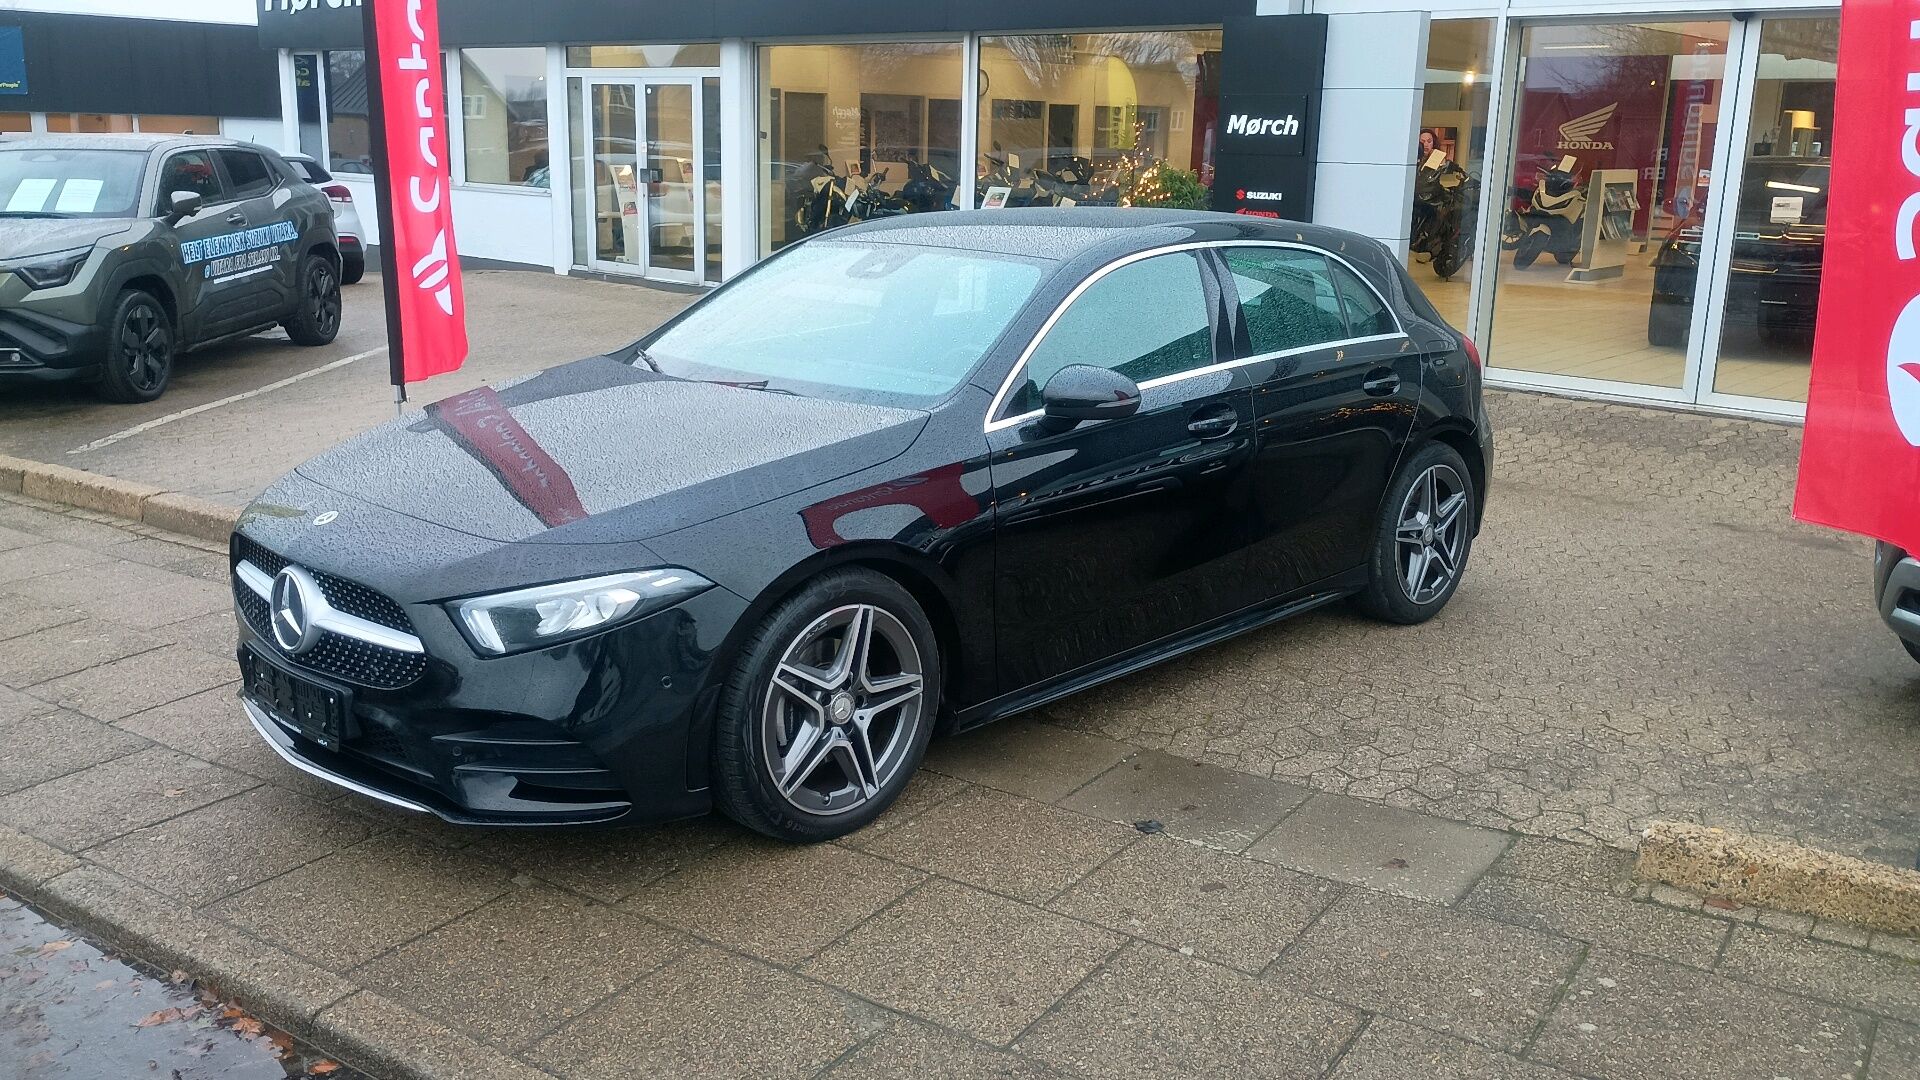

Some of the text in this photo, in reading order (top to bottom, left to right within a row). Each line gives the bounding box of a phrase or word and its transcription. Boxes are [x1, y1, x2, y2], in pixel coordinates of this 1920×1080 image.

[1226, 114, 1299, 136] Mørch
[1556, 141, 1614, 150] HONDA
[1246, 191, 1282, 201] SUZUKI
[181, 241, 204, 264] HELT
[203, 231, 246, 259] ELEKTRISK
[245, 226, 271, 250] SUZUKI
